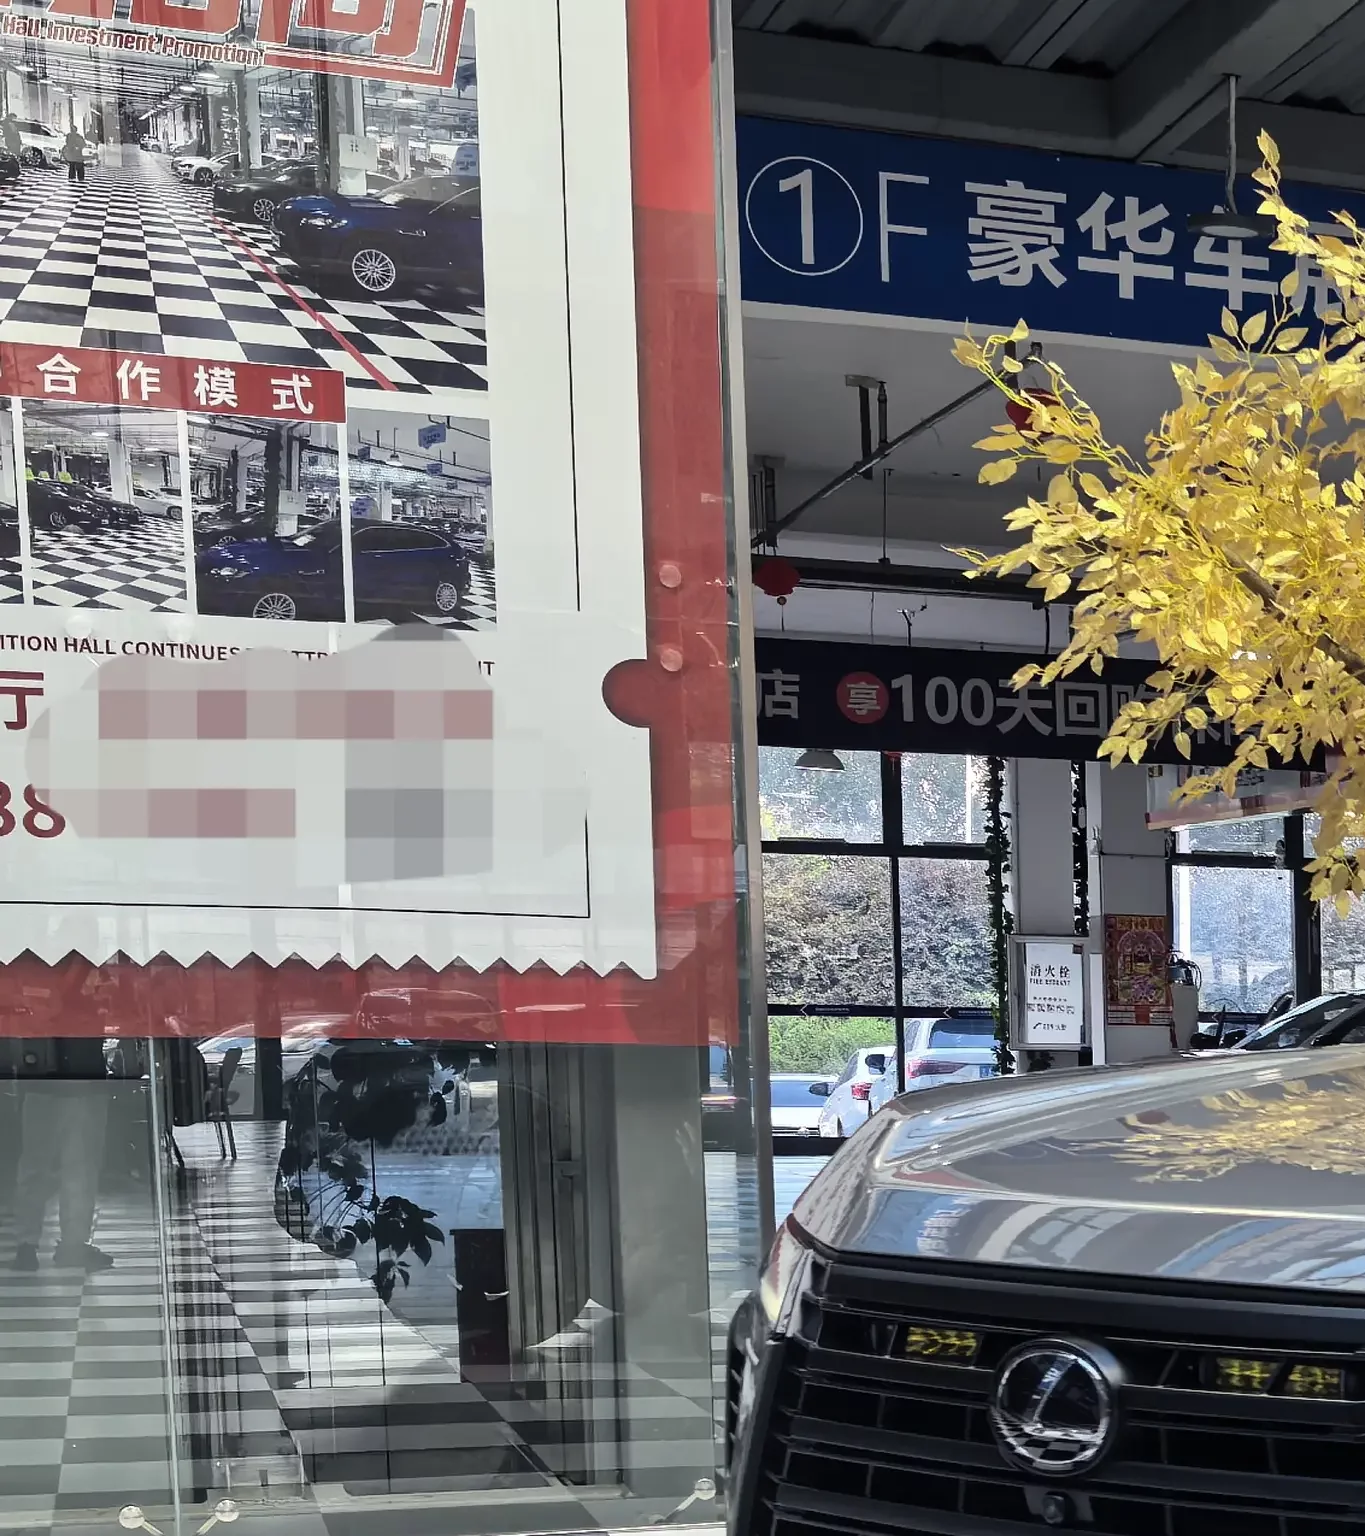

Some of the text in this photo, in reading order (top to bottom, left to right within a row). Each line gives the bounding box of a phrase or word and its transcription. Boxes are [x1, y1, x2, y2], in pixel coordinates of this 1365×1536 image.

[1, 14, 43, 38] Hall
[46, 22, 157, 54] Investment
[160, 37, 264, 67] Promotion
[37, 352, 314, 416] 合作模式
[64, 636, 117, 655] HALL
